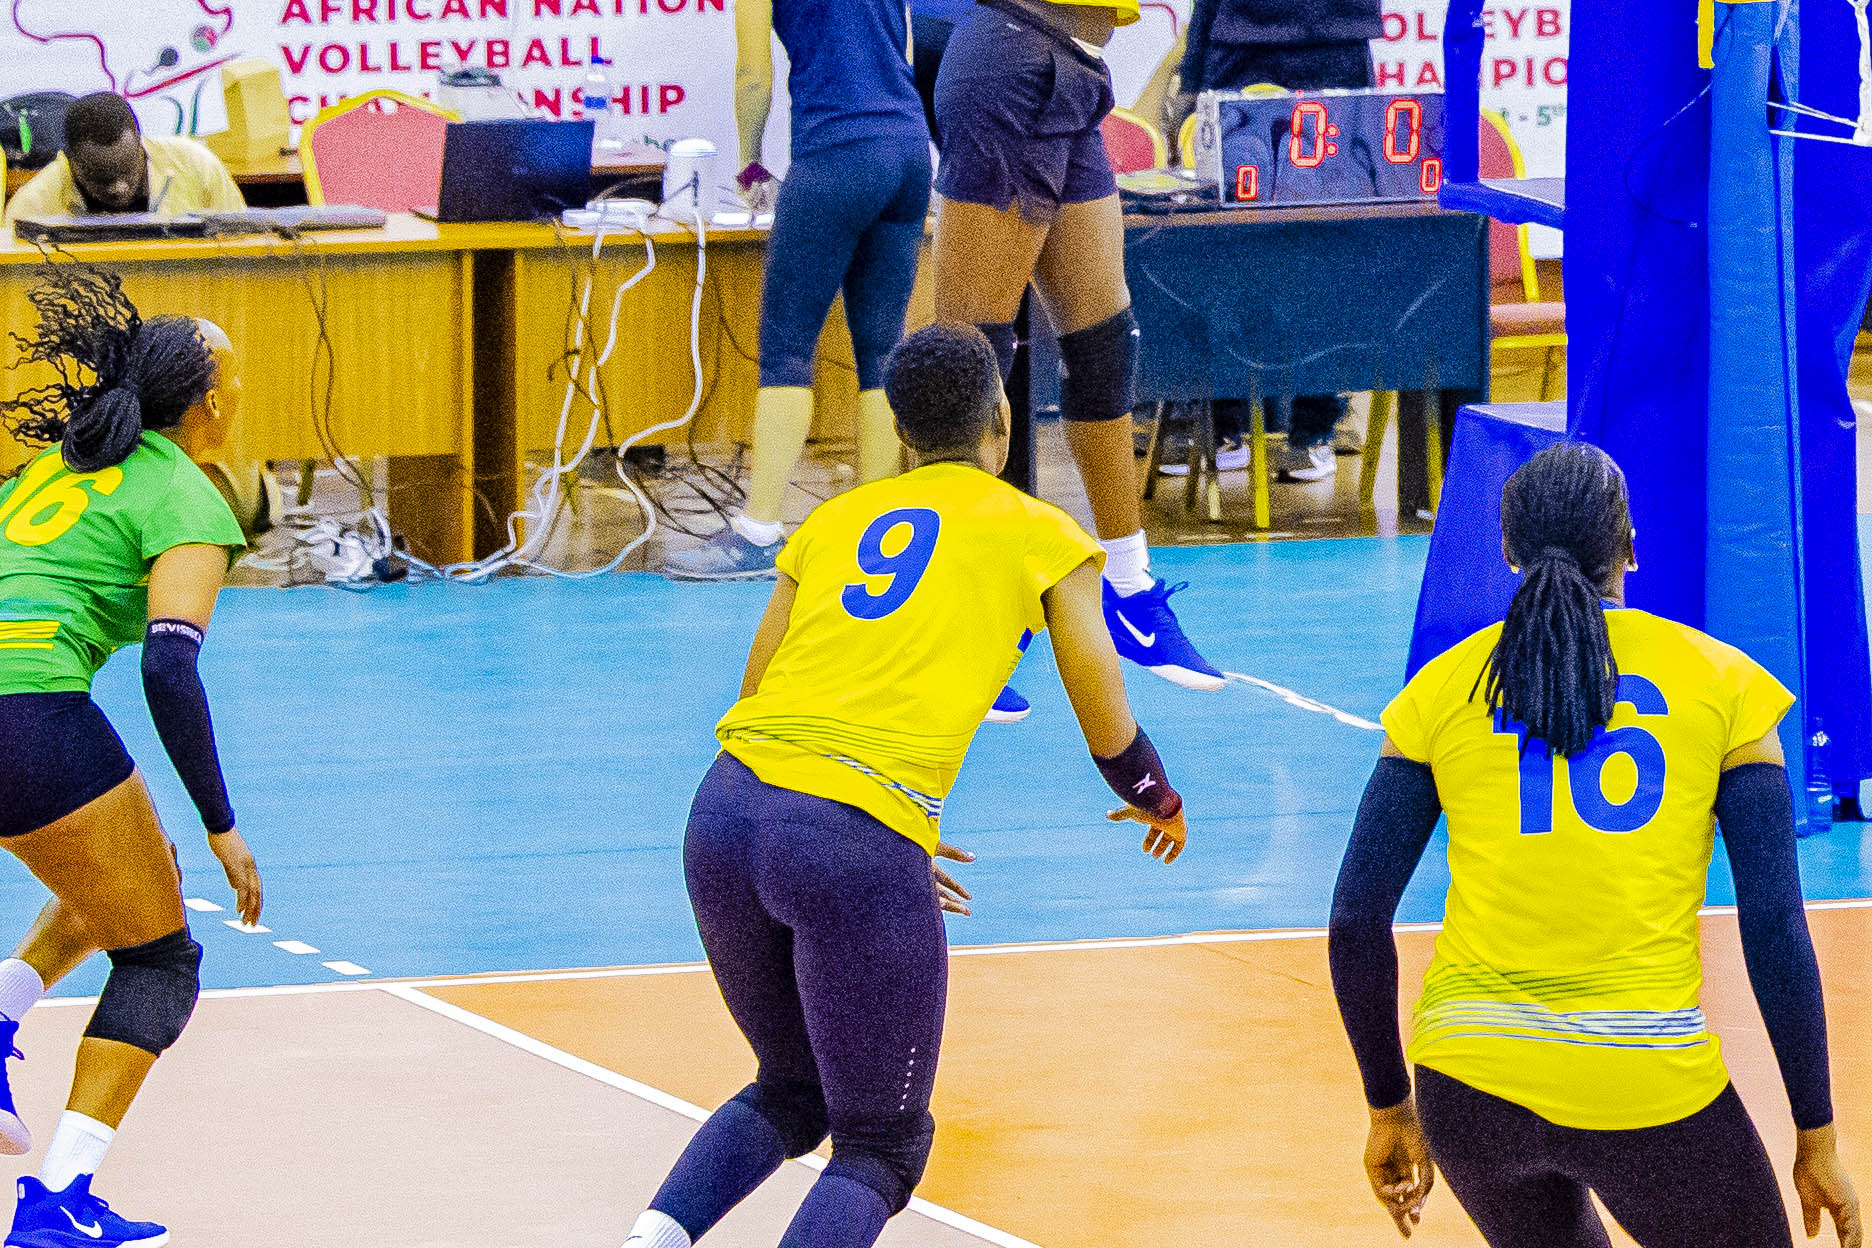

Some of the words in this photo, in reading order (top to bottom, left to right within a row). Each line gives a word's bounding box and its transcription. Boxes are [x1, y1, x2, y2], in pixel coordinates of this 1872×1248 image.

[280, 36, 613, 74] VOLLEYBALL
[1235, 164, 1259, 201] 0
[1419, 158, 1442, 194] 0
[840, 507, 942, 620] 9
[1492, 673, 1669, 835] 16
